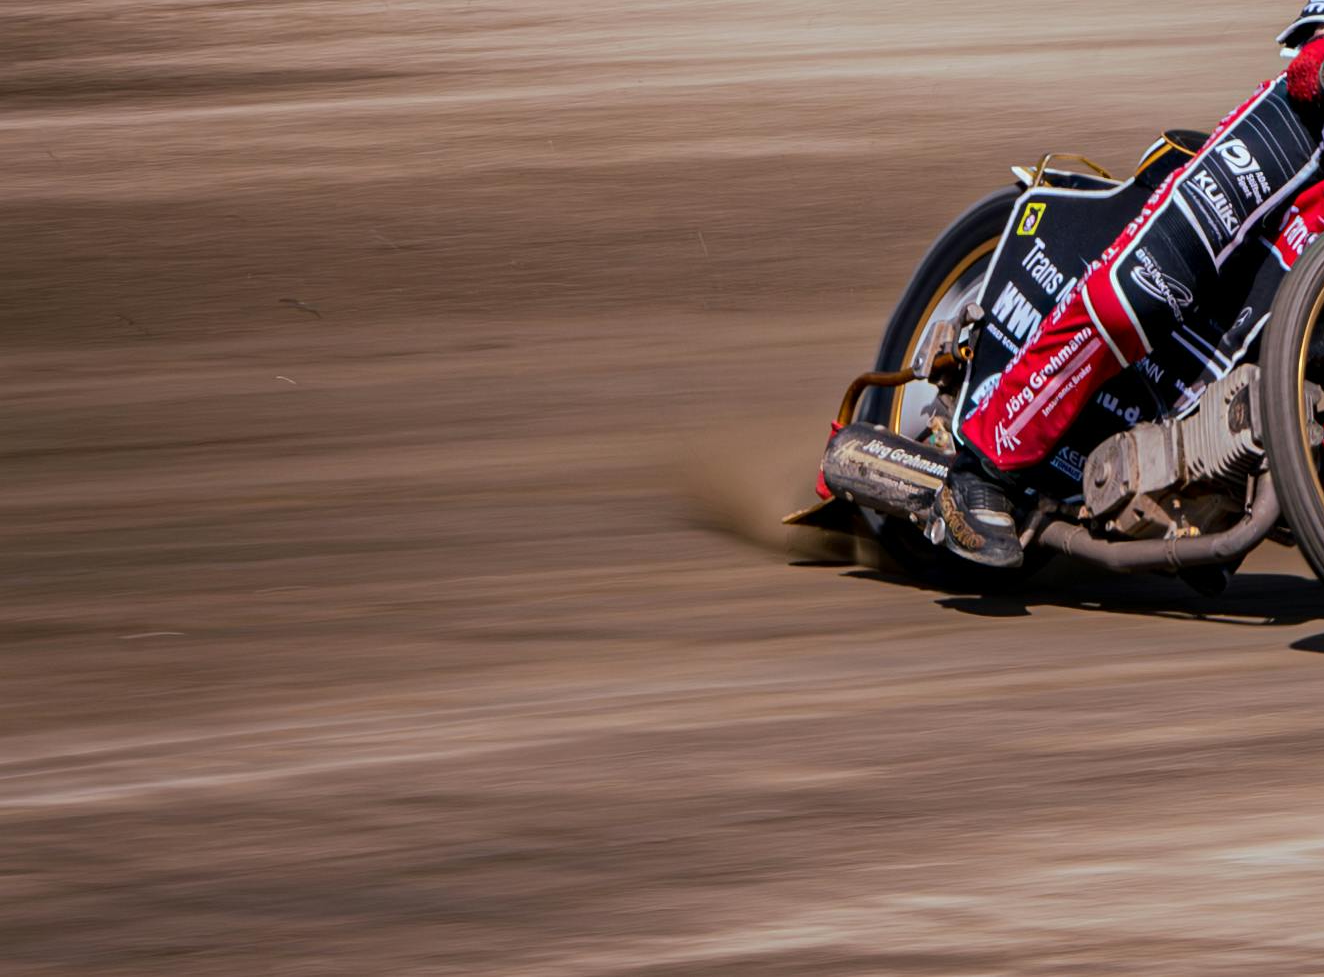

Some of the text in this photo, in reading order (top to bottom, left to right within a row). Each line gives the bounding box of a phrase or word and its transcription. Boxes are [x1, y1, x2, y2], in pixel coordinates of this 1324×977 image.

[1021, 236, 1065, 296] Trans
[1004, 386, 1035, 420] Jörg
[1029, 326, 1093, 390] Grohmann
[862, 439, 891, 460] Jörg
